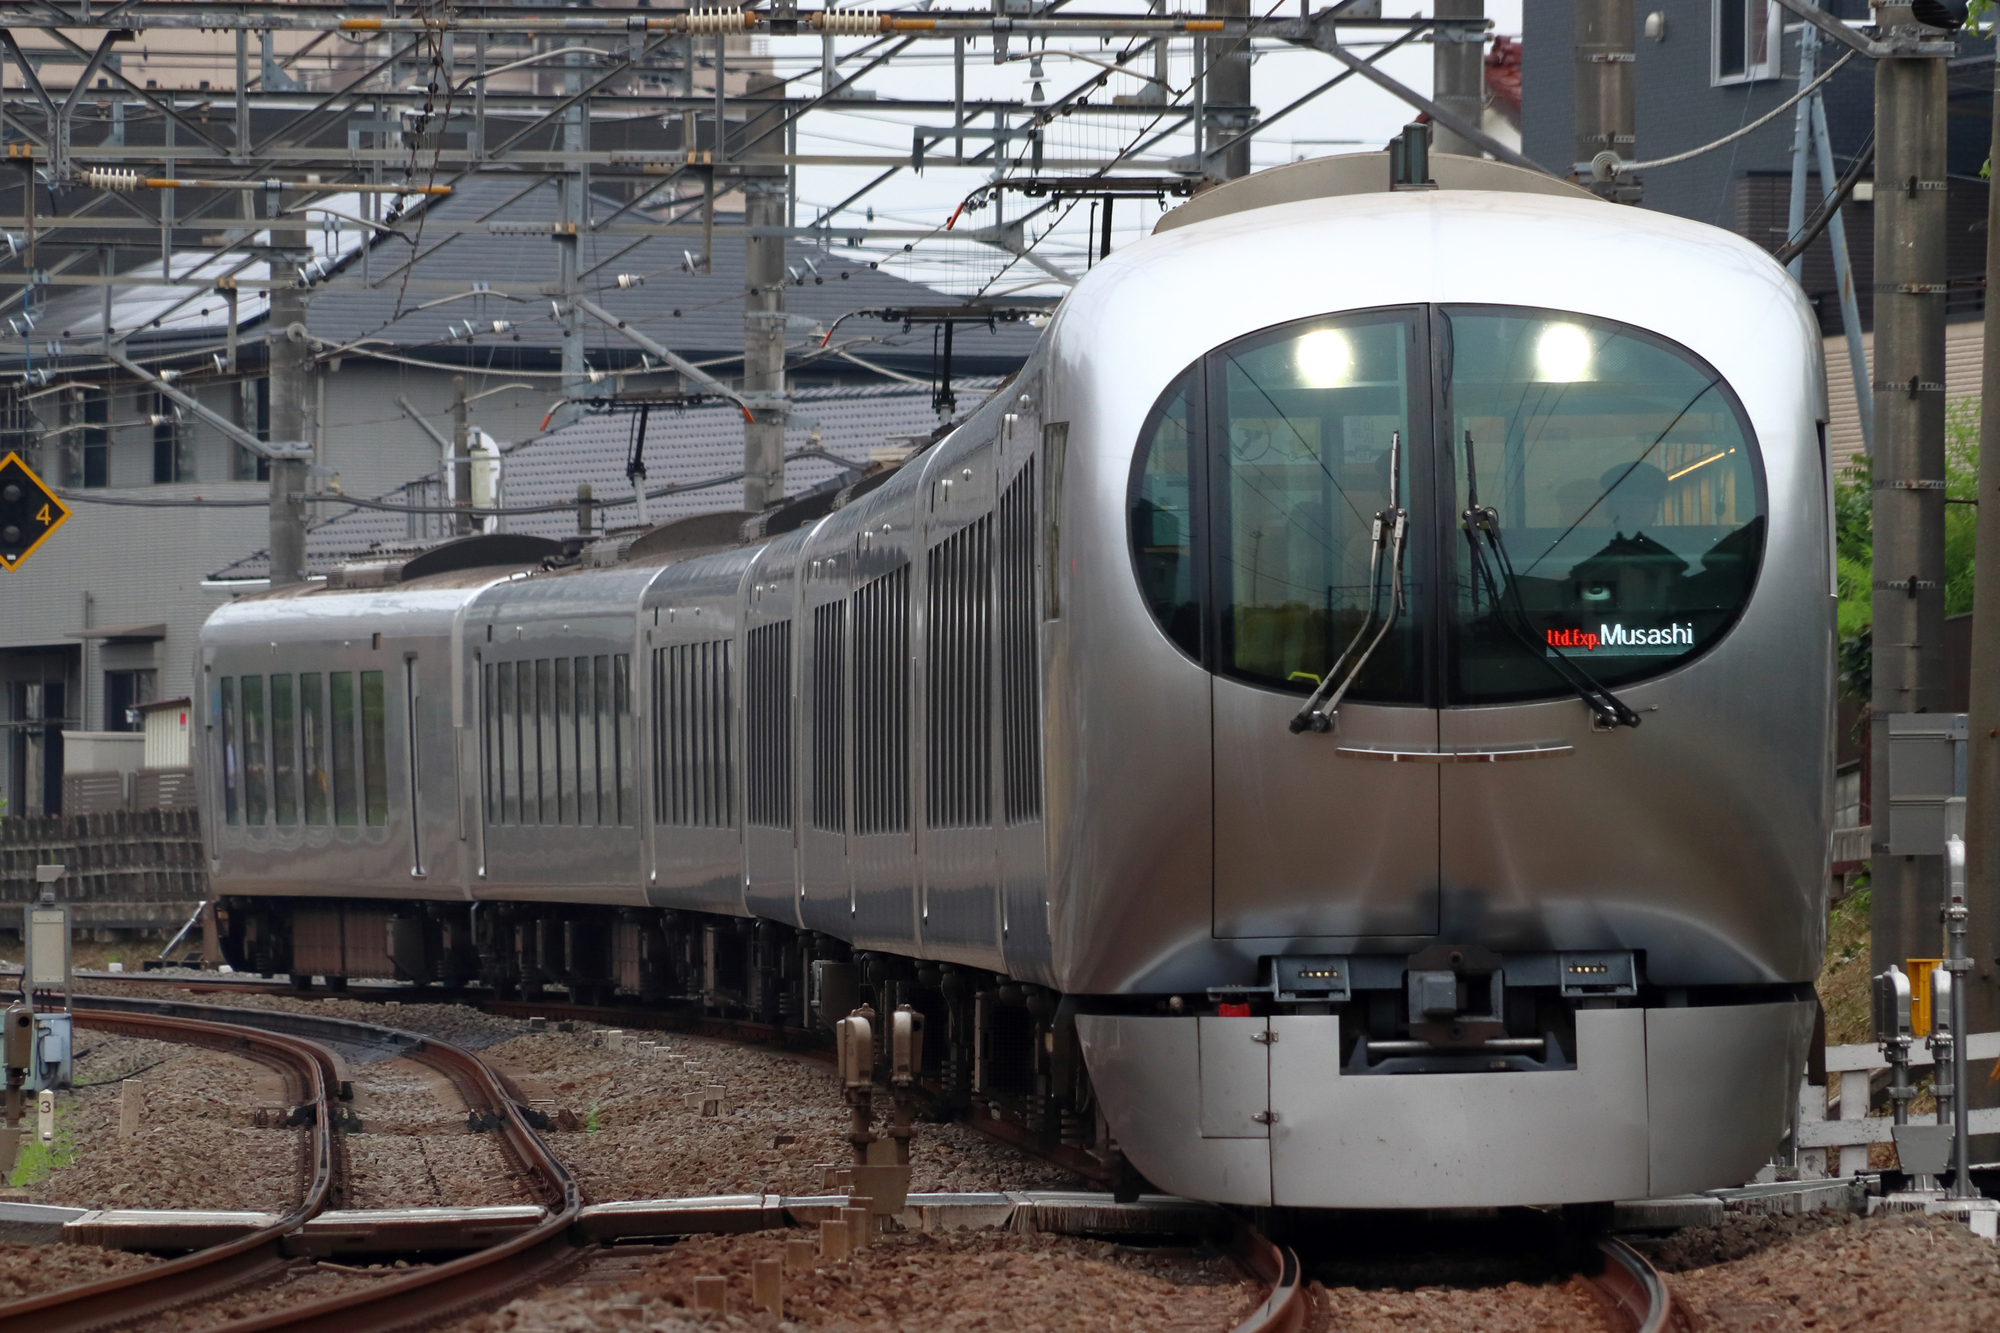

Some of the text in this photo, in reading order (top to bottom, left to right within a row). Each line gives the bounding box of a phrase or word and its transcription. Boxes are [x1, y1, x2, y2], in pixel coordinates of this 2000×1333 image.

[35, 503, 52, 526] 4
[1600, 622, 1693, 645] Musashi
[40, 1100, 51, 1114] 3
